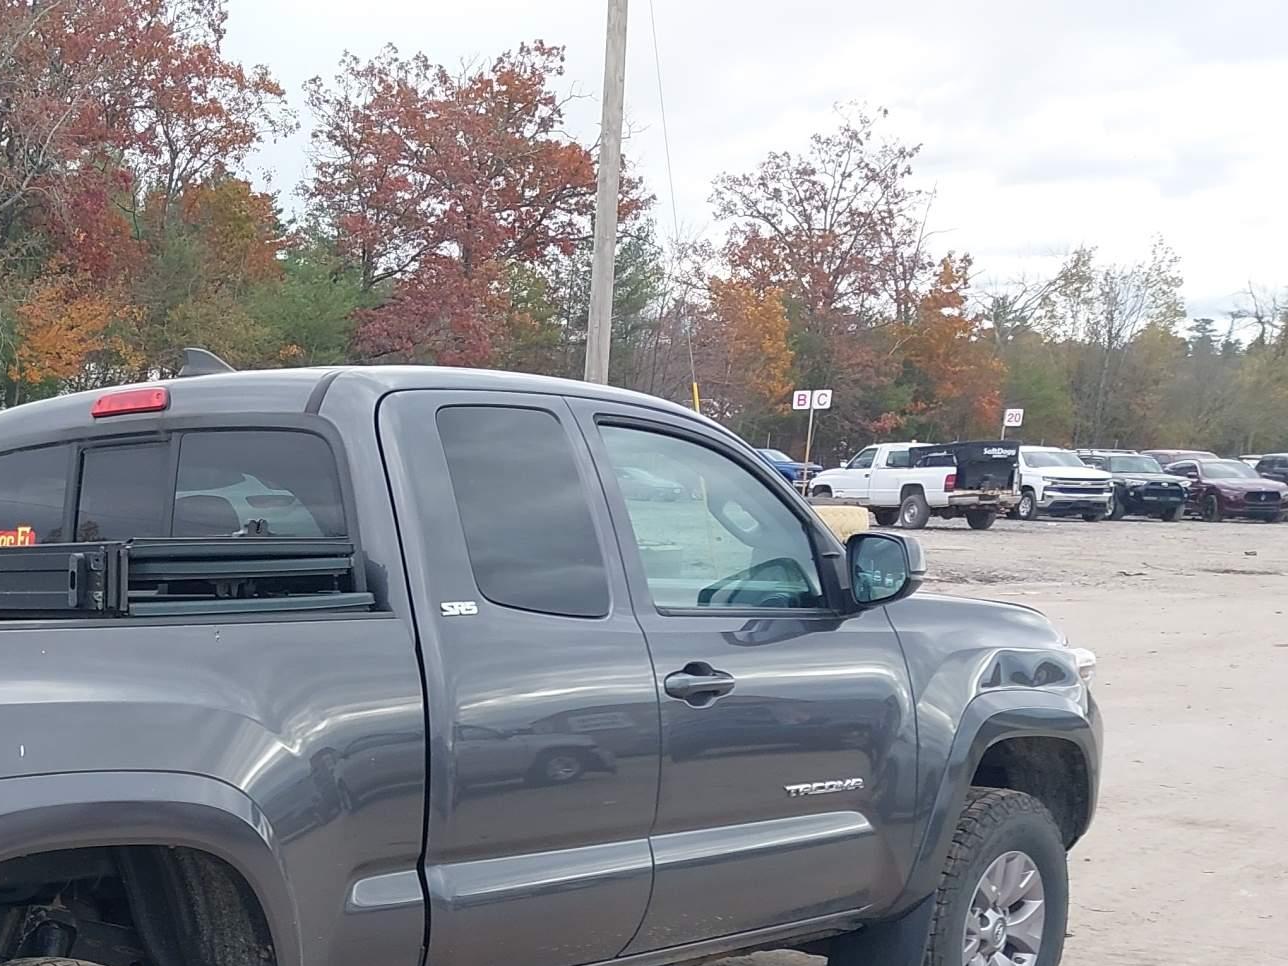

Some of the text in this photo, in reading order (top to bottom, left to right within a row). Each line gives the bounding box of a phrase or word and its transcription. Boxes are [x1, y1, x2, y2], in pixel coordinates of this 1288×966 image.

[797, 393, 807, 407] B
[817, 392, 828, 406] C
[1007, 412, 1021, 423] 20
[441, 601, 479, 616] SR5
[783, 777, 865, 797] TACOMA
